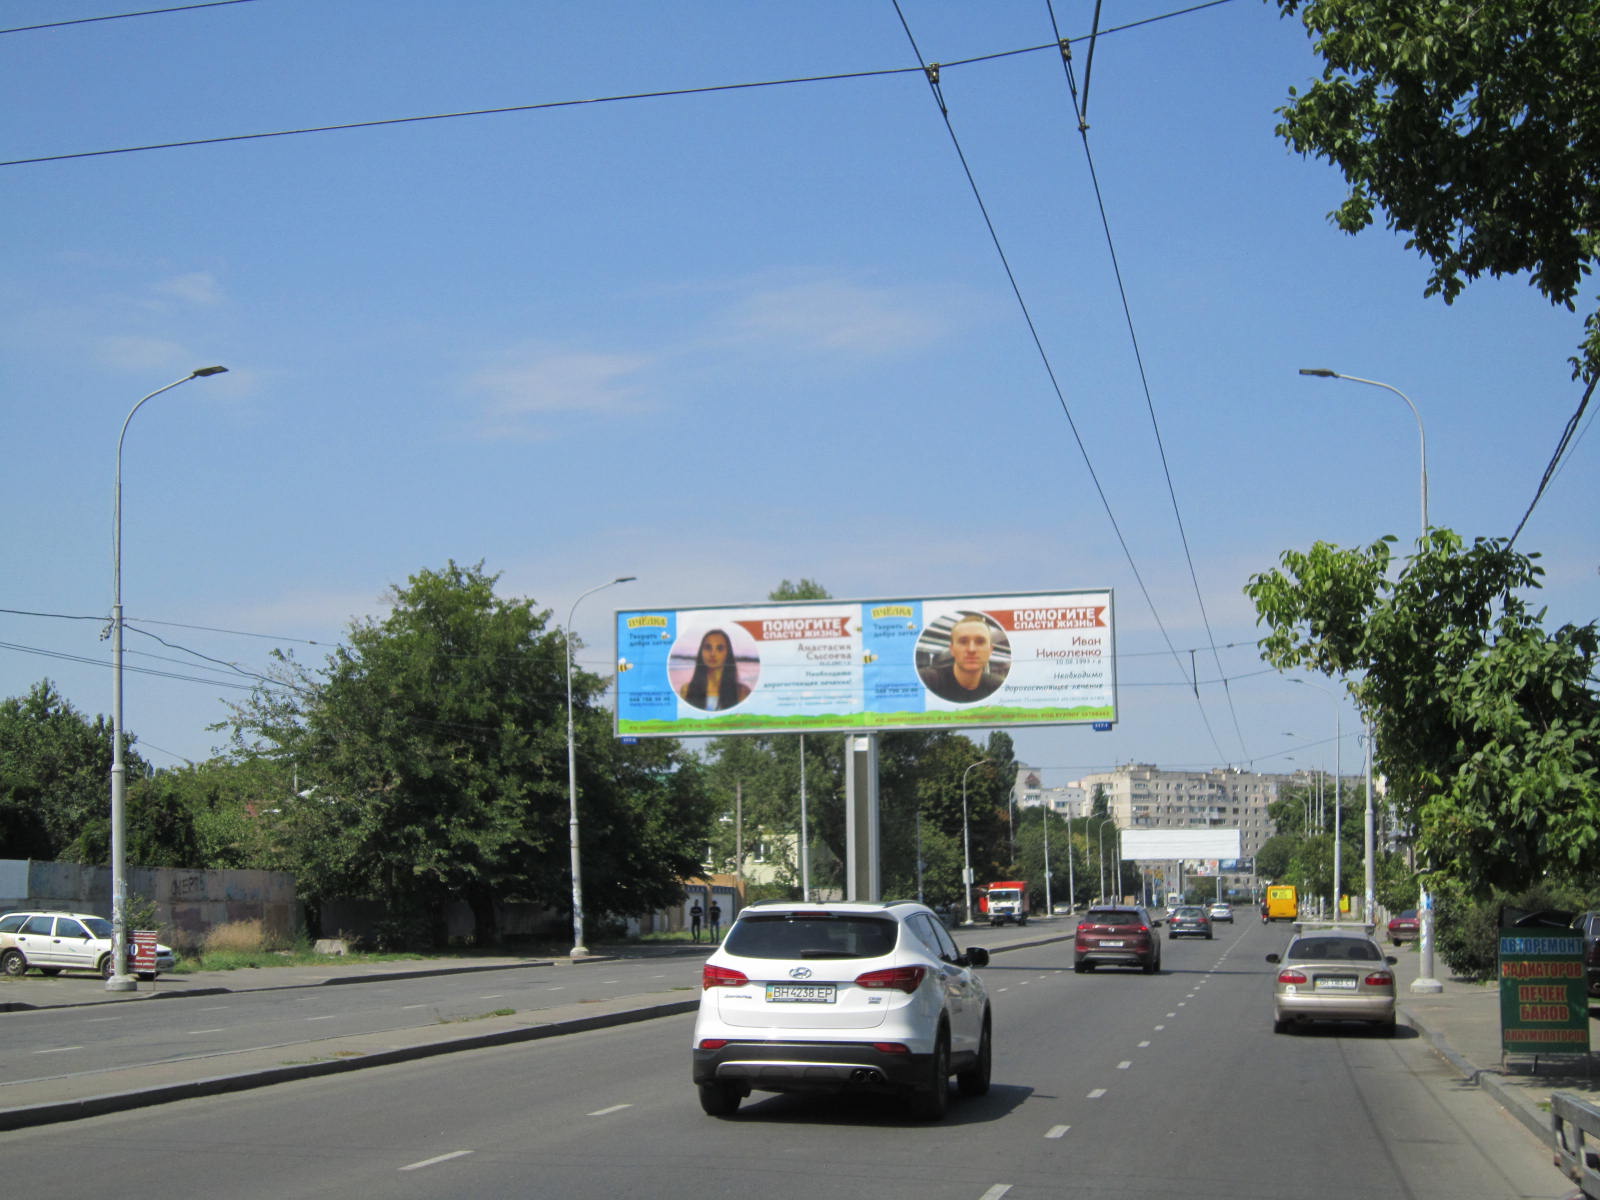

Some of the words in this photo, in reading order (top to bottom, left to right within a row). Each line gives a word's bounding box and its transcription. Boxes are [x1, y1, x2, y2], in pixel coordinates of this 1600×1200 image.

[1013, 608, 1095, 621] ПОМОГИТЕ
[763, 618, 841, 632] ПОМОГИТЕ
[1013, 621, 1054, 630] СПАСТИ
[763, 631, 801, 640] СПАСТИ
[1072, 636, 1102, 646] Иван
[798, 643, 852, 652] Анастасия
[1036, 648, 1102, 658] Николенко
[806, 652, 852, 660] Сысоева
[1053, 671, 1103, 680] Необходимо
[1501, 937, 1583, 954] АВТОРЕМОНТ
[1502, 962, 1583, 979] РАДИАТОРОВ
[774, 987, 789, 997] BH
[791, 988, 814, 997] 4238
[818, 988, 833, 998] EP
[1519, 986, 1567, 1002] ПЕЧЕК
[1520, 1005, 1569, 1021] БАКОВ
[1505, 1029, 1587, 1042] АККУМУЛЯТОРОВ
